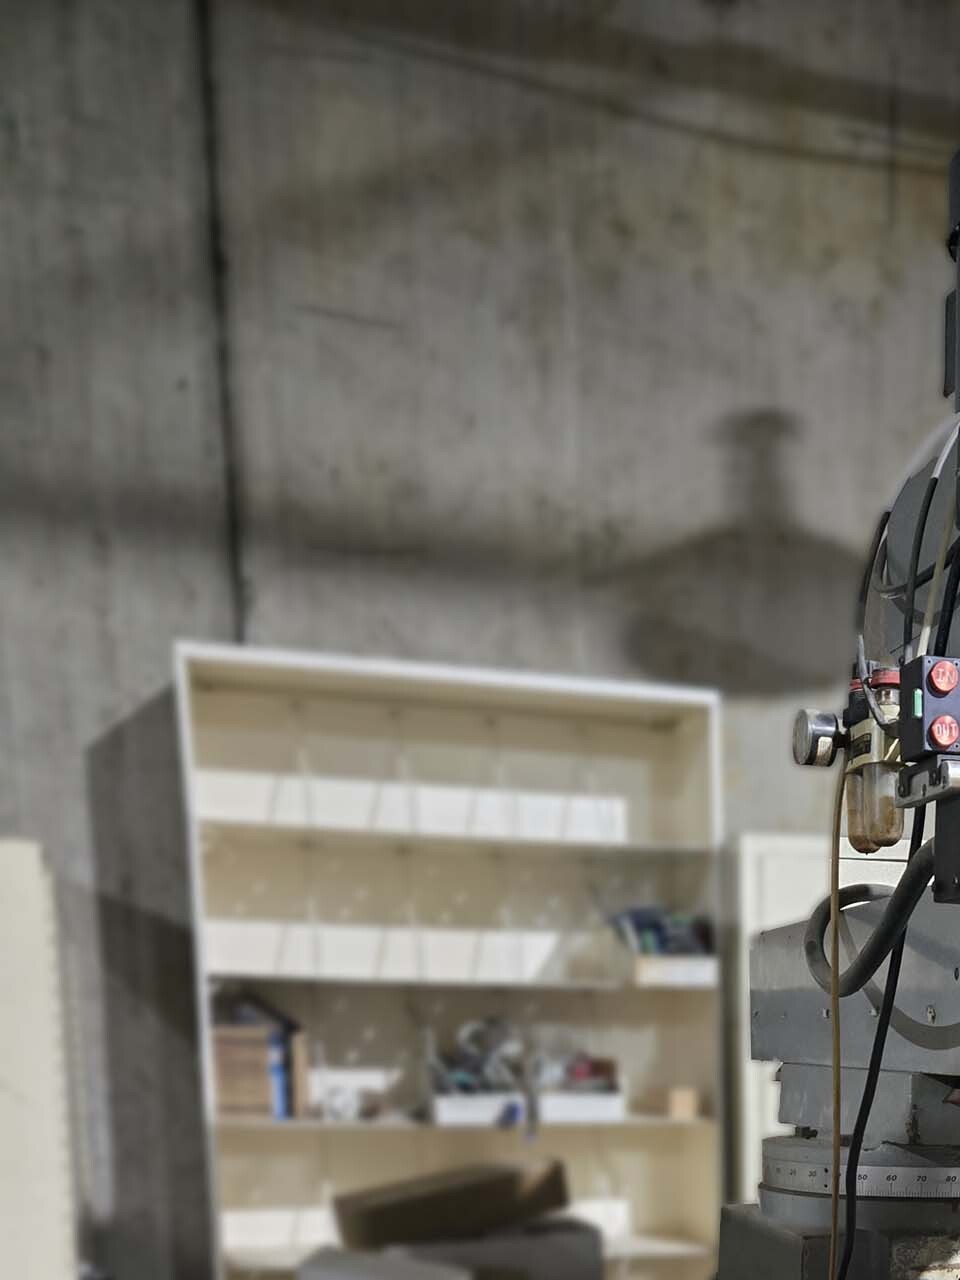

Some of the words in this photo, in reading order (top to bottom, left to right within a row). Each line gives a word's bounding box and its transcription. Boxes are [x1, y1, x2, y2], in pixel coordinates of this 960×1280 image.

[937, 668, 956, 684] IN
[936, 723, 957, 737] OUT
[886, 1174, 897, 1182] 60
[916, 1175, 927, 1183] 70
[945, 1175, 957, 1183] 80
